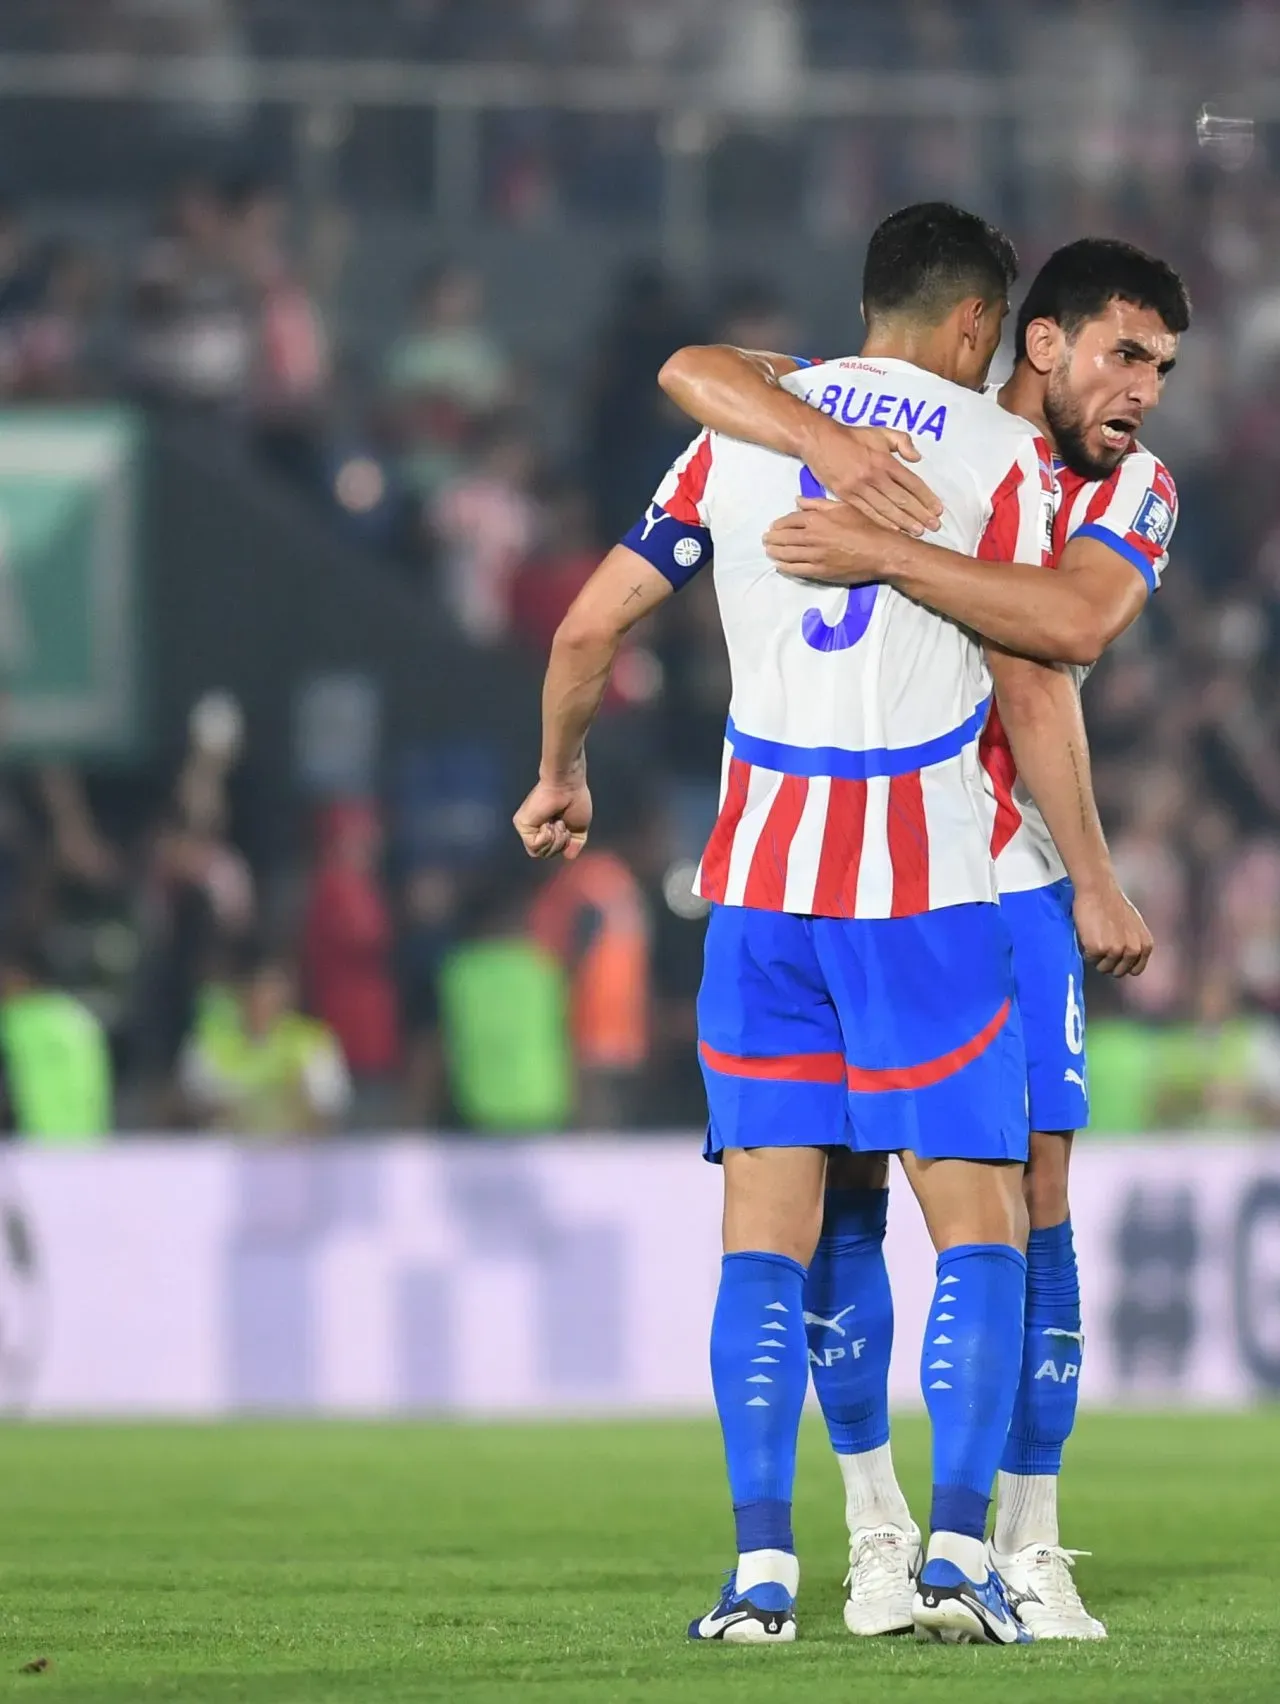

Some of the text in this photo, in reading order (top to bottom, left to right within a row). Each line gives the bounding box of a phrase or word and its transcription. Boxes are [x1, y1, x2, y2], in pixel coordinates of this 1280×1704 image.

[838, 361, 888, 377] PARAGUAY
[805, 384, 947, 442] BUENA
[1065, 973, 1083, 1055] 6
[807, 1337, 867, 1367] APF
